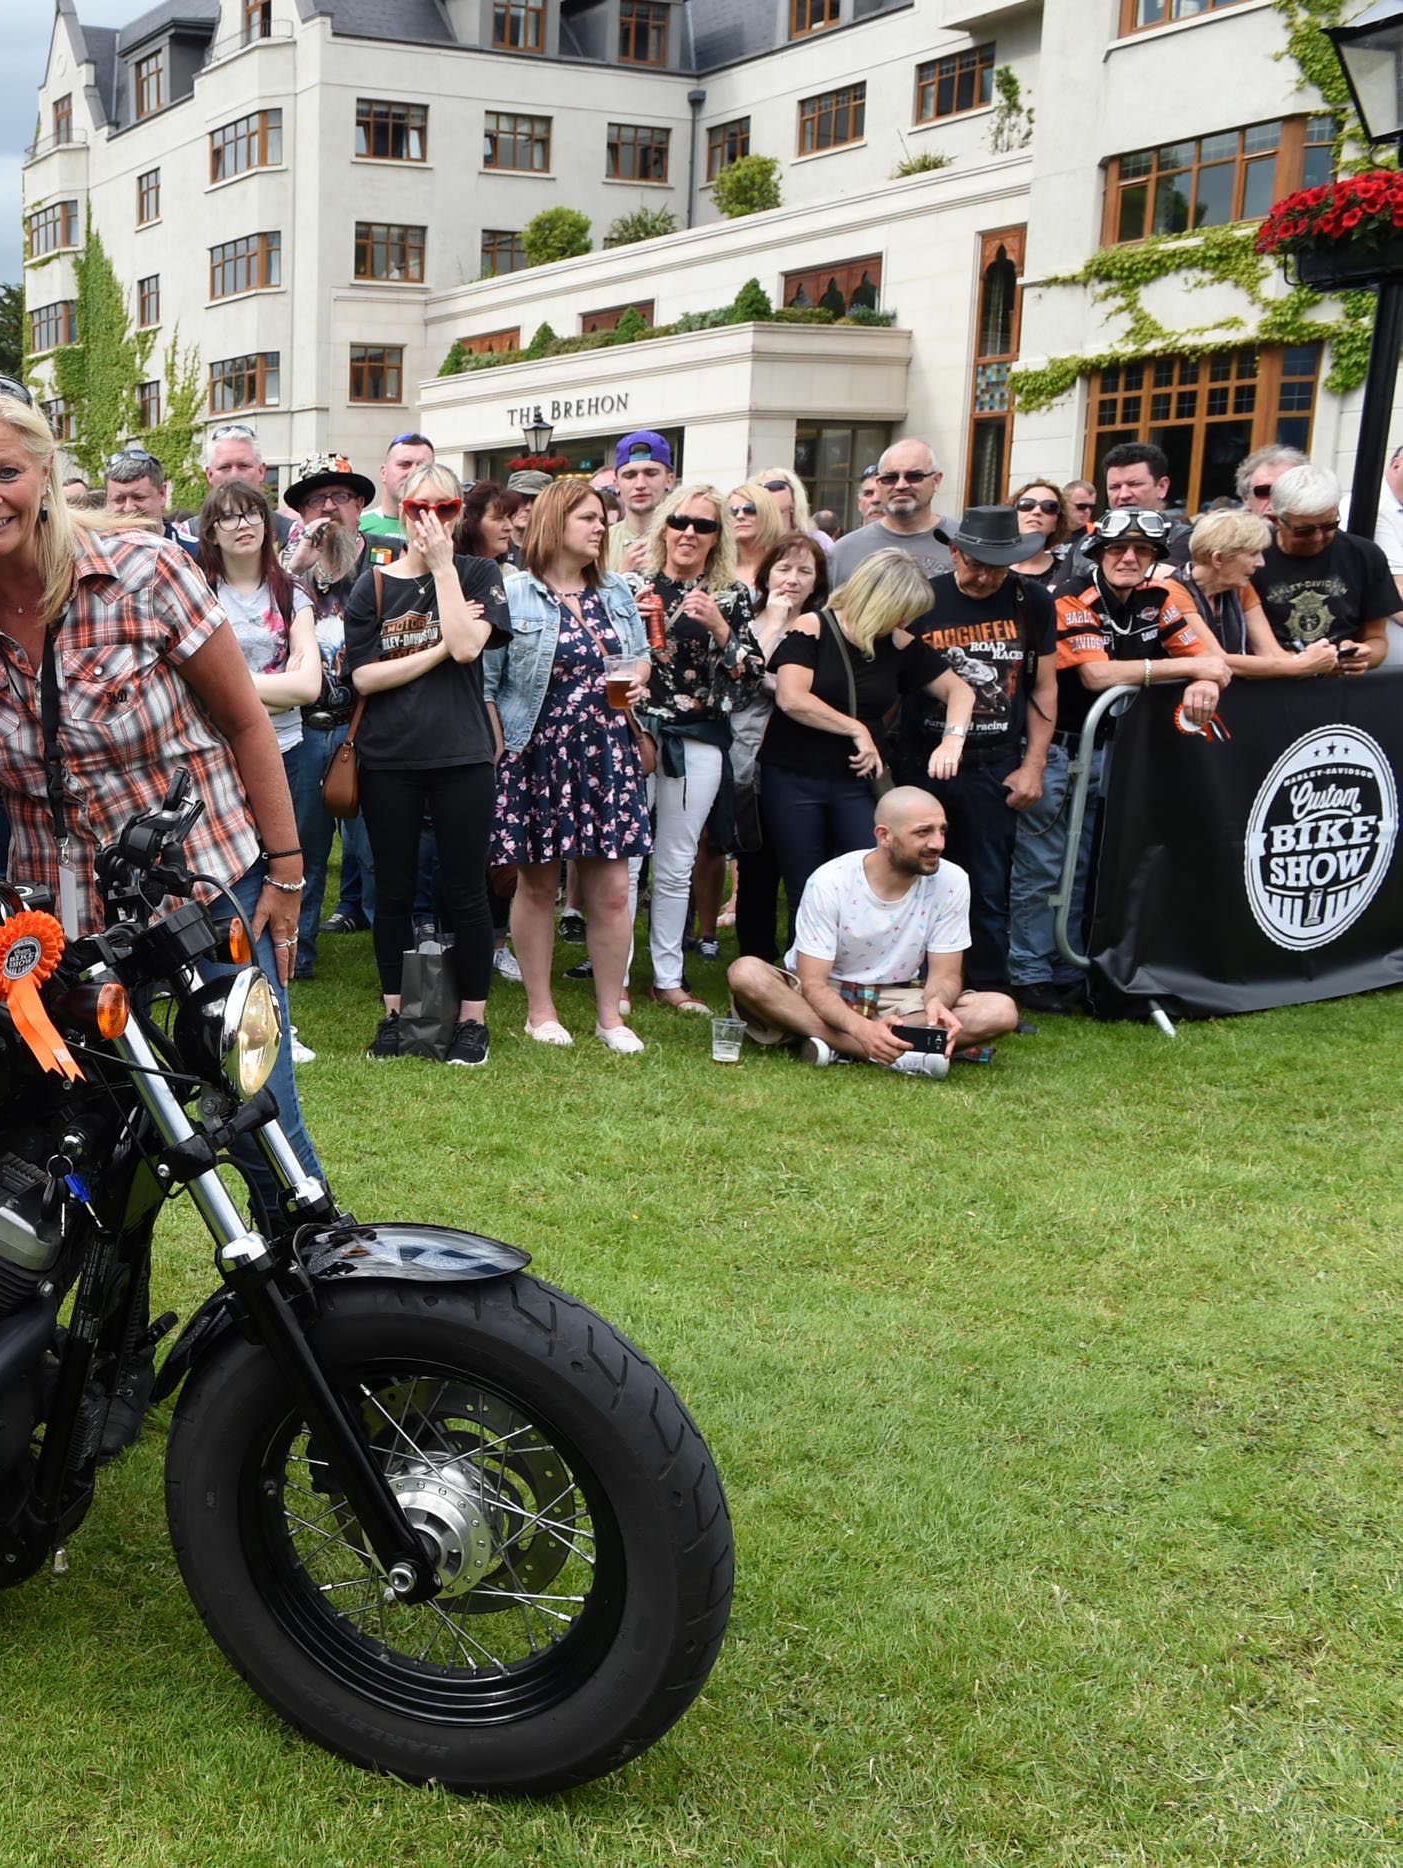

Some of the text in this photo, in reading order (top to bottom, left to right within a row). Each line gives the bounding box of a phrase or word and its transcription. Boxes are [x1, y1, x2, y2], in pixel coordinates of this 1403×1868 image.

[551, 393, 629, 420] BREHON
[386, 616, 425, 633] MOTOR
[970, 641, 1006, 652] ROAD
[976, 720, 1009, 732] racing
[1283, 767, 1374, 787] HARLEY-DAVIDSON
[1290, 780, 1362, 820] Custom
[1270, 815, 1378, 853] BIKE
[1269, 847, 1370, 888] SHOW
[9, 952, 35, 962] BIKE
[9, 957, 33, 968] SHOW
